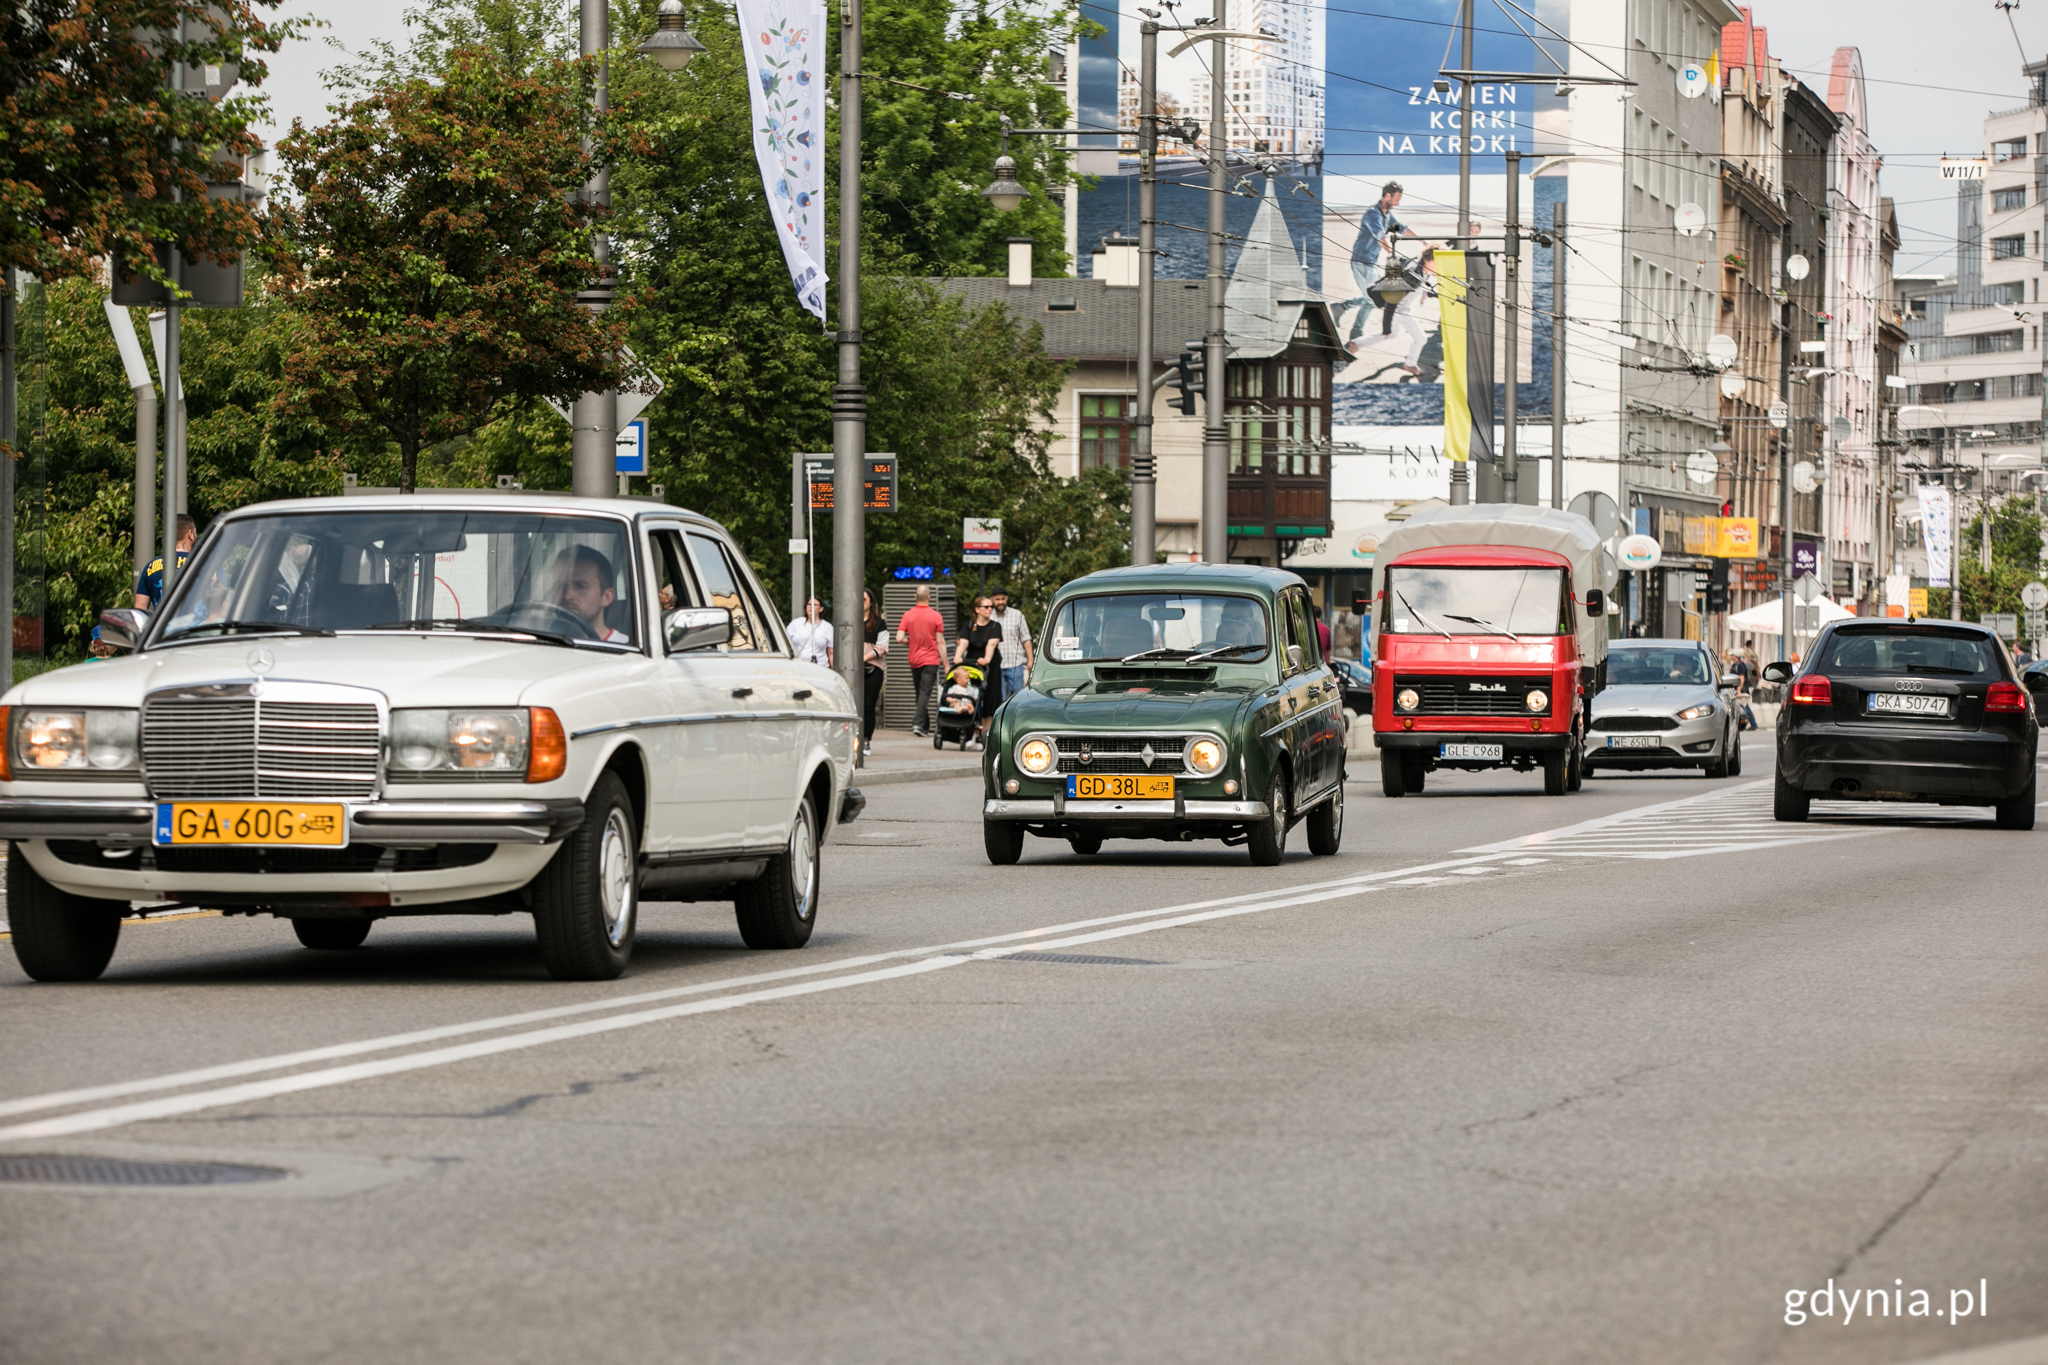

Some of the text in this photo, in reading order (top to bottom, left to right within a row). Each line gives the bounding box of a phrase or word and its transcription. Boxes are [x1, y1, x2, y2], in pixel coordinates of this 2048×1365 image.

[1430, 110, 1515, 129] KORKI
[1378, 135, 1515, 154] NA KROKI
[1747, 572, 1776, 582] Apteka
[1876, 694, 1901, 708] GKA
[1906, 696, 1946, 711] 50747
[1448, 745, 1469, 756] GLE
[1473, 745, 1500, 757] C968
[1614, 737, 1627, 747] WE
[1079, 777, 1105, 796] GD
[1112, 777, 1145, 796] 38L
[159, 808, 293, 839] PL GA 60G
